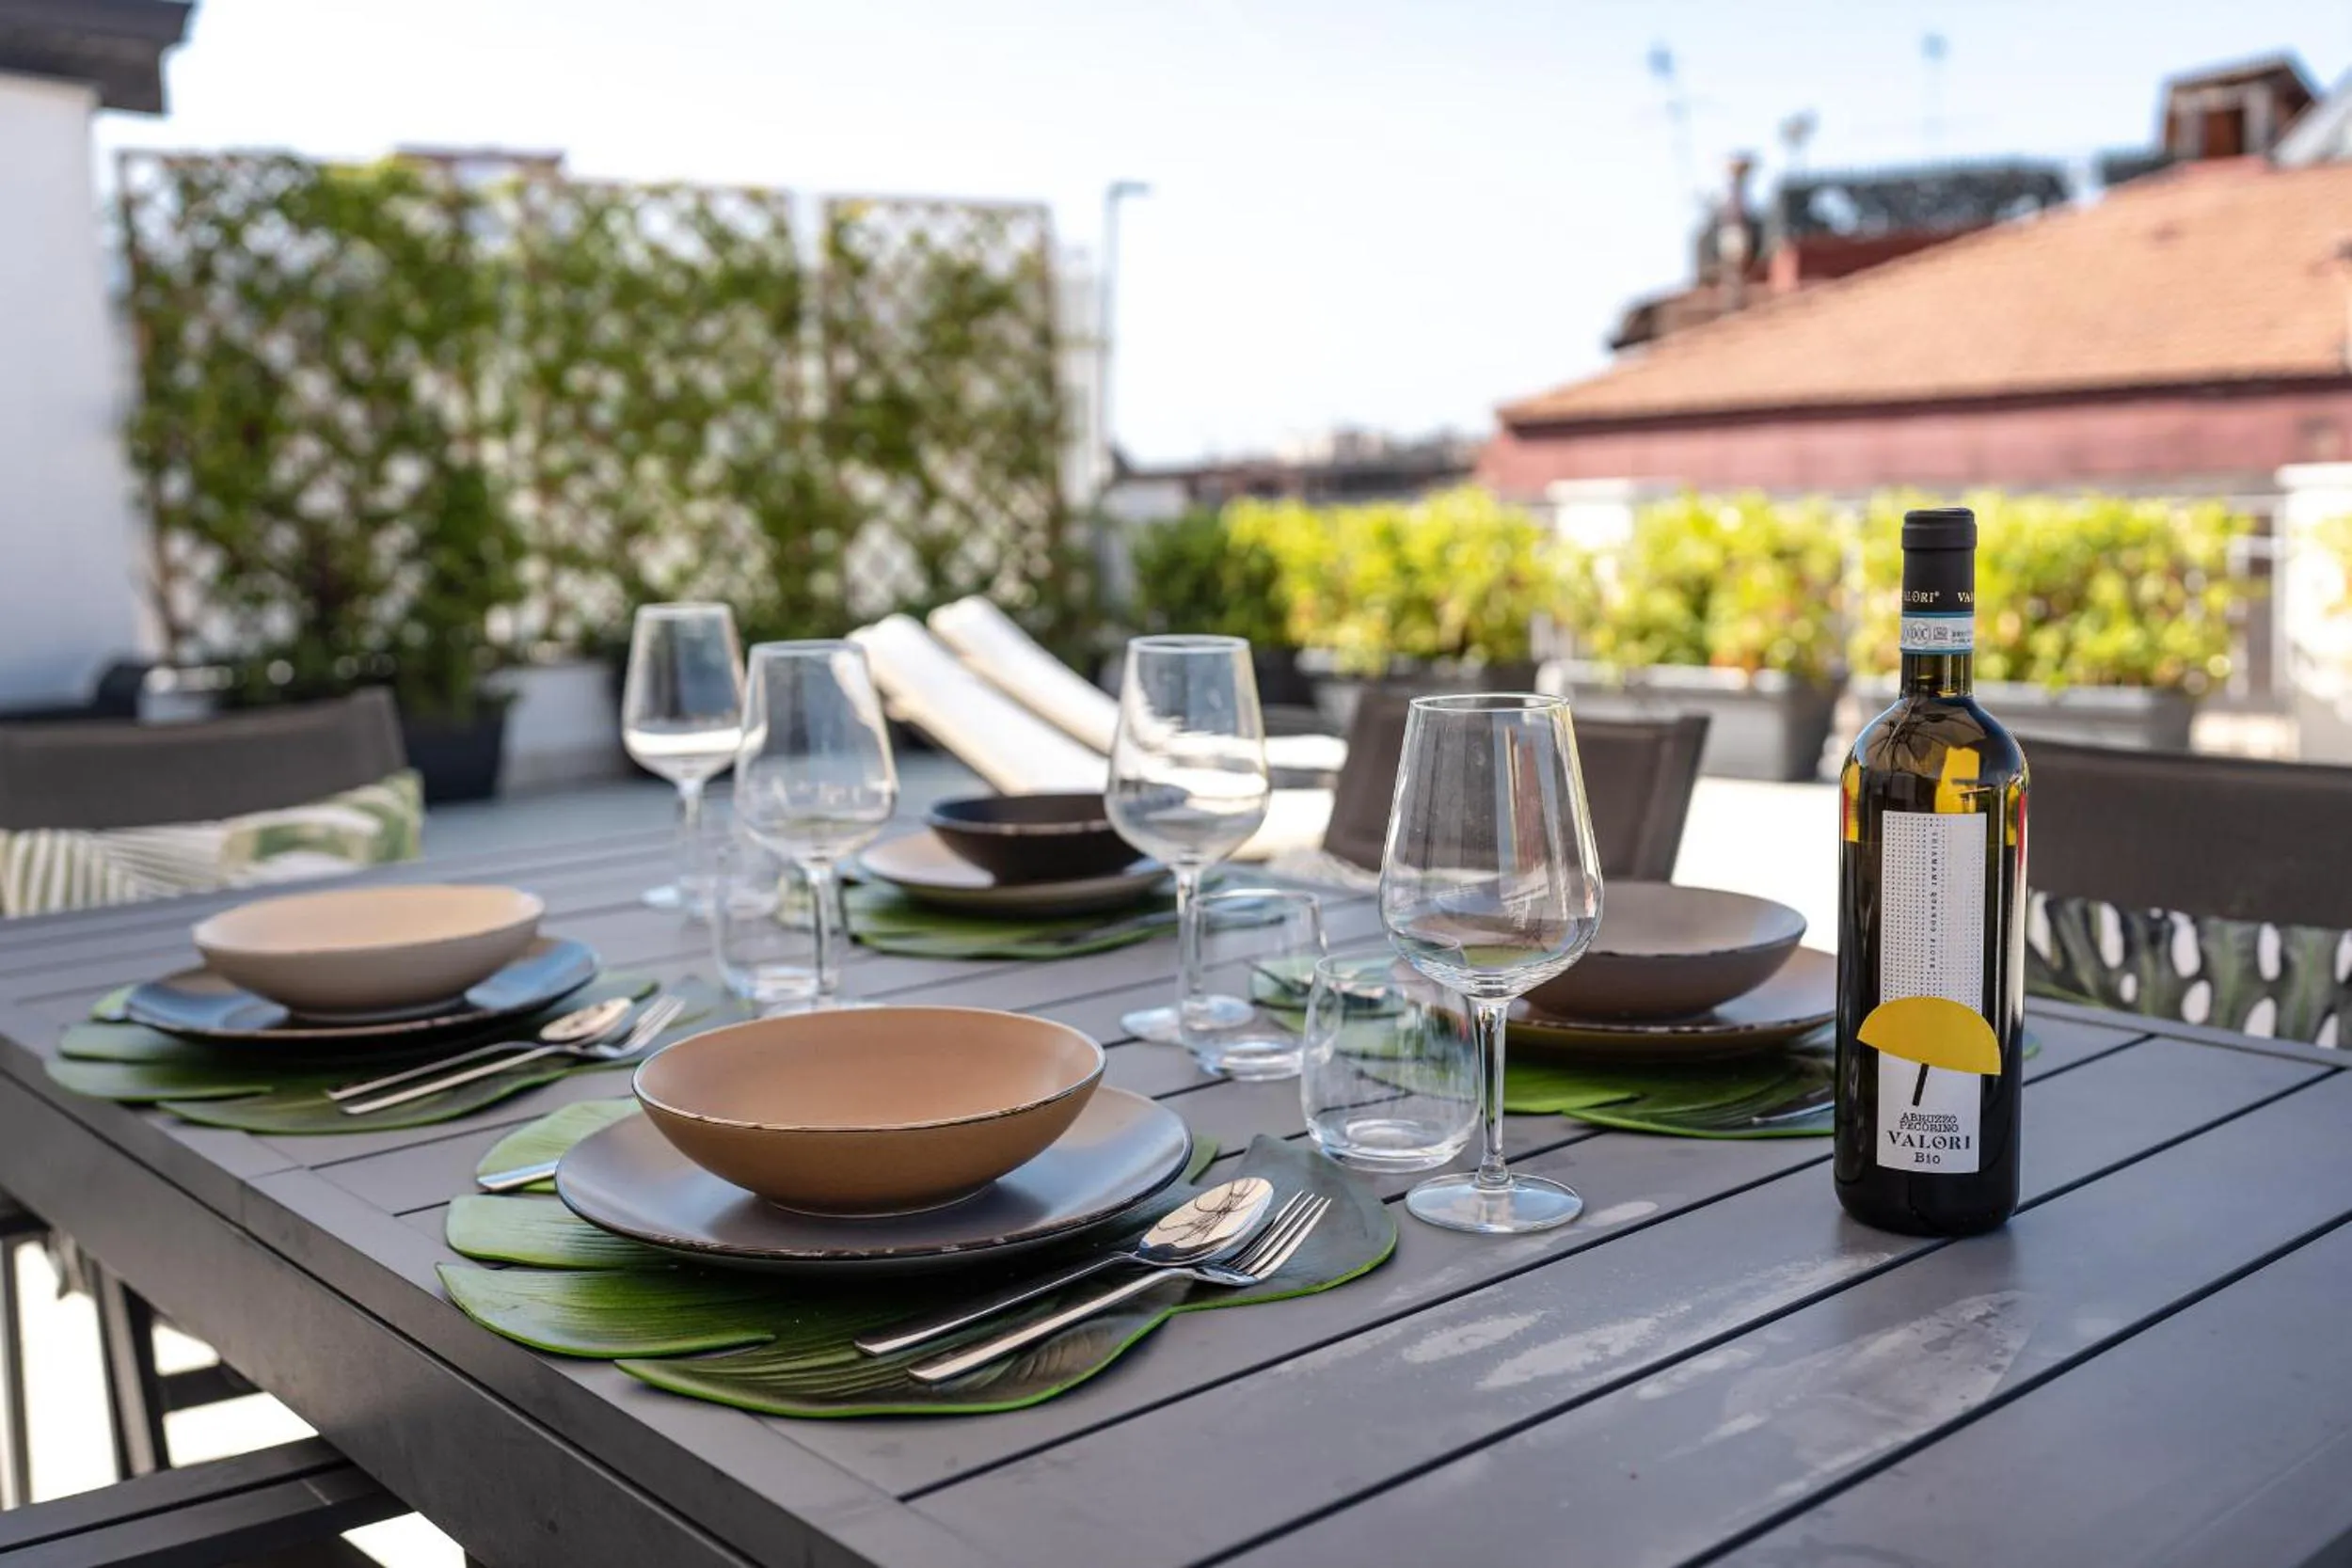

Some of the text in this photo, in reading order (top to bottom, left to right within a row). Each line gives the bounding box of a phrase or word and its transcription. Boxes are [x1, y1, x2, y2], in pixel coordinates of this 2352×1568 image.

[1900, 1112, 1958, 1124] ABRUZZO
[1899, 1120, 1959, 1133] PECORINO
[1887, 1131, 1970, 1149] VALORI
